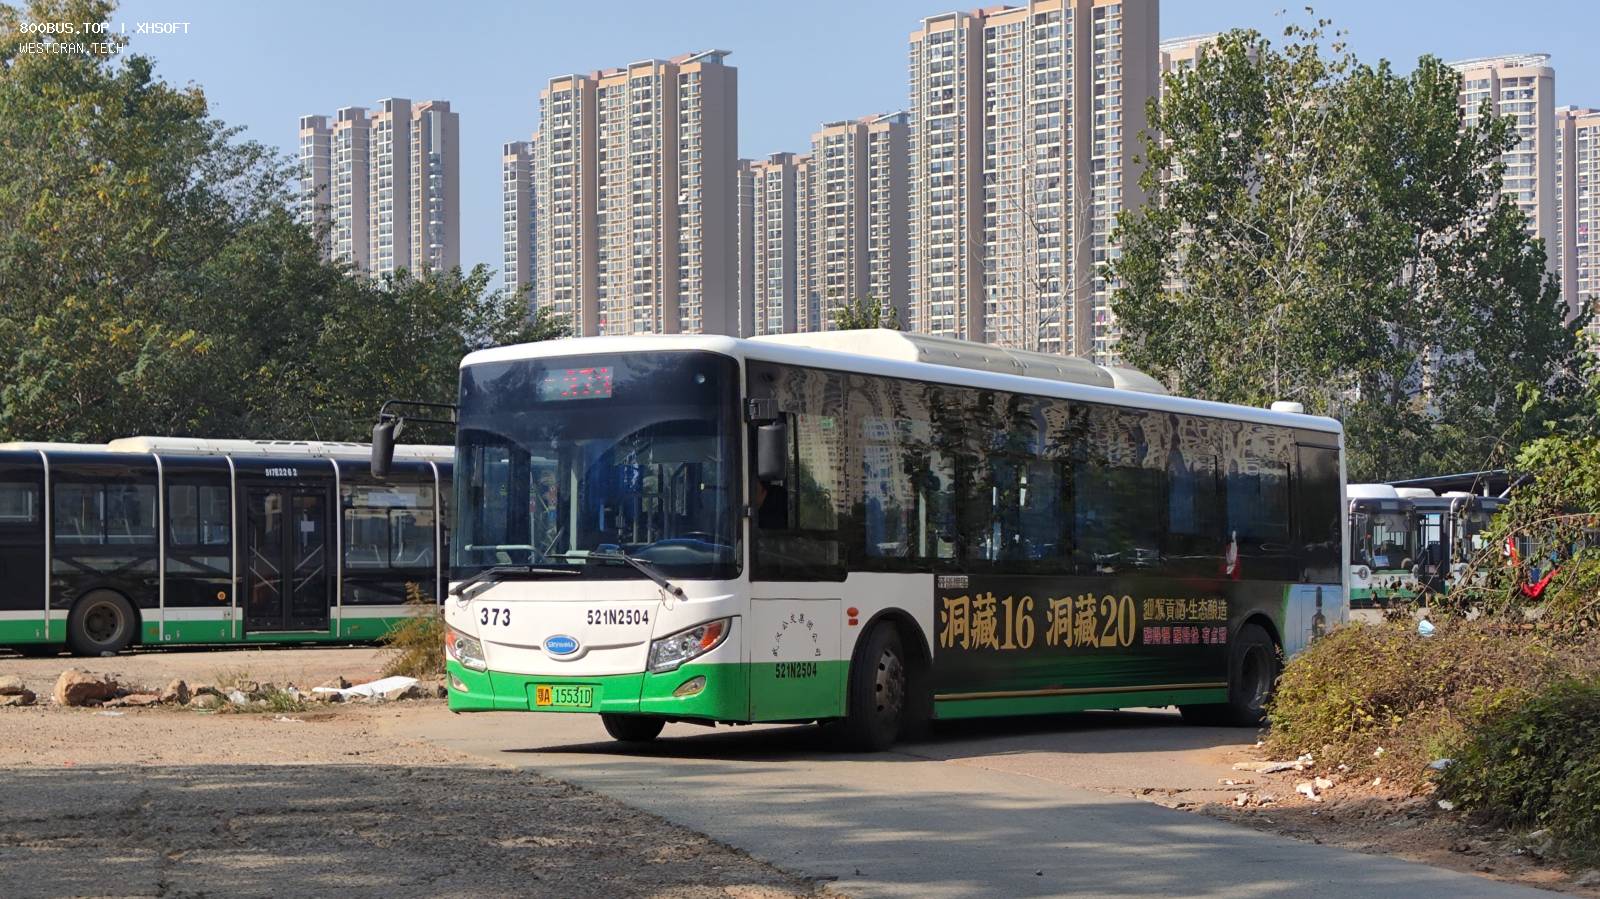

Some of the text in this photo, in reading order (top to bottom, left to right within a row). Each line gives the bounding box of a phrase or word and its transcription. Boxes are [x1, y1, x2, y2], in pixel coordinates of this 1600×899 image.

[480, 607, 511, 627] 373
[587, 609, 649, 625] 521N2504
[940, 592, 1136, 650] 洞藏16 洞藏20
[775, 661, 817, 678] 521N2504
[556, 688, 591, 704] 15531D
